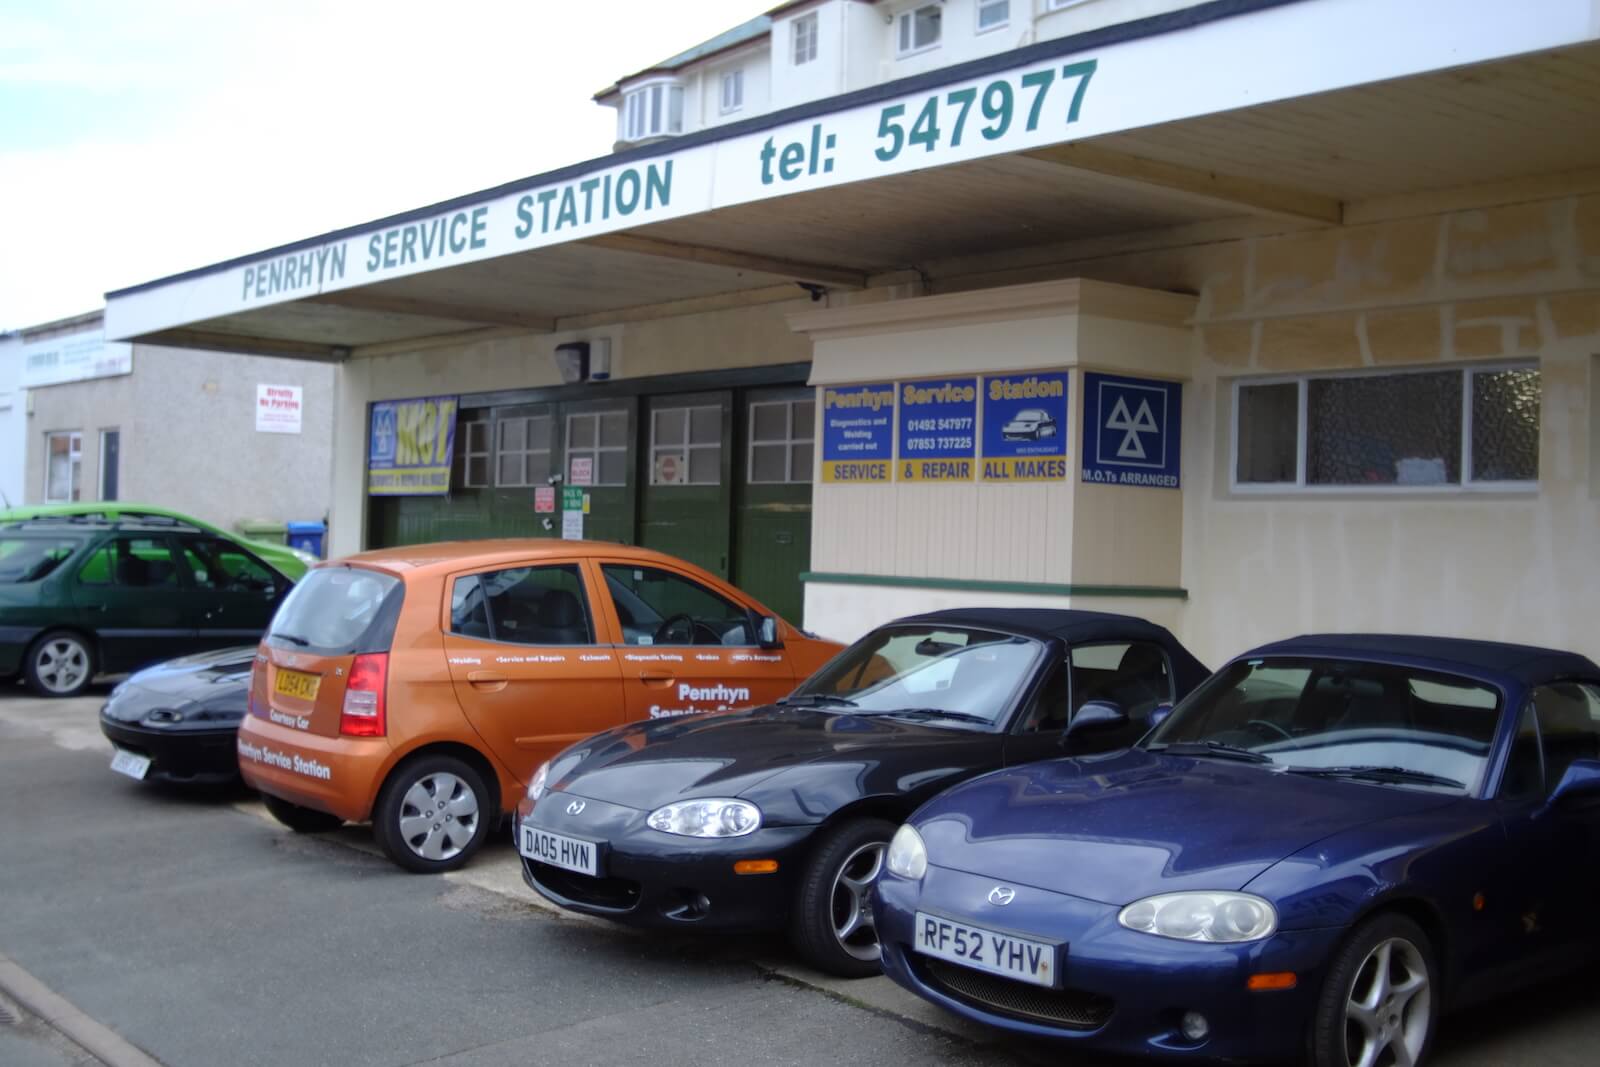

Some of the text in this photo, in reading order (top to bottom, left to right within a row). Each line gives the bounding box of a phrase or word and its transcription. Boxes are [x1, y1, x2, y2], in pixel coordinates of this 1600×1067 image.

[243, 58, 1098, 301] PENRHYN SERVICE STATION tel: 547977
[825, 377, 1064, 411] Penrhyn Service Station
[272, 399, 299, 410] Parking
[396, 399, 456, 465] MOT
[830, 417, 888, 428] Diagnostics and
[907, 418, 972, 431] 01492 547977
[844, 430, 872, 440] Welding
[907, 437, 972, 450] 07853 737225
[834, 460, 1066, 480] SERVICE & REPAIR ALL MAKES
[1120, 472, 1177, 487] ARRANGED
[499, 656, 524, 664] Service
[540, 655, 566, 664] Repairs
[679, 684, 749, 704] Penrhyn
[270, 709, 310, 729] Courtesy Car
[263, 747, 292, 770] Service
[294, 755, 331, 780] Station
[526, 830, 590, 869] DA05 HVN
[924, 918, 1042, 975] RF52 YHV
